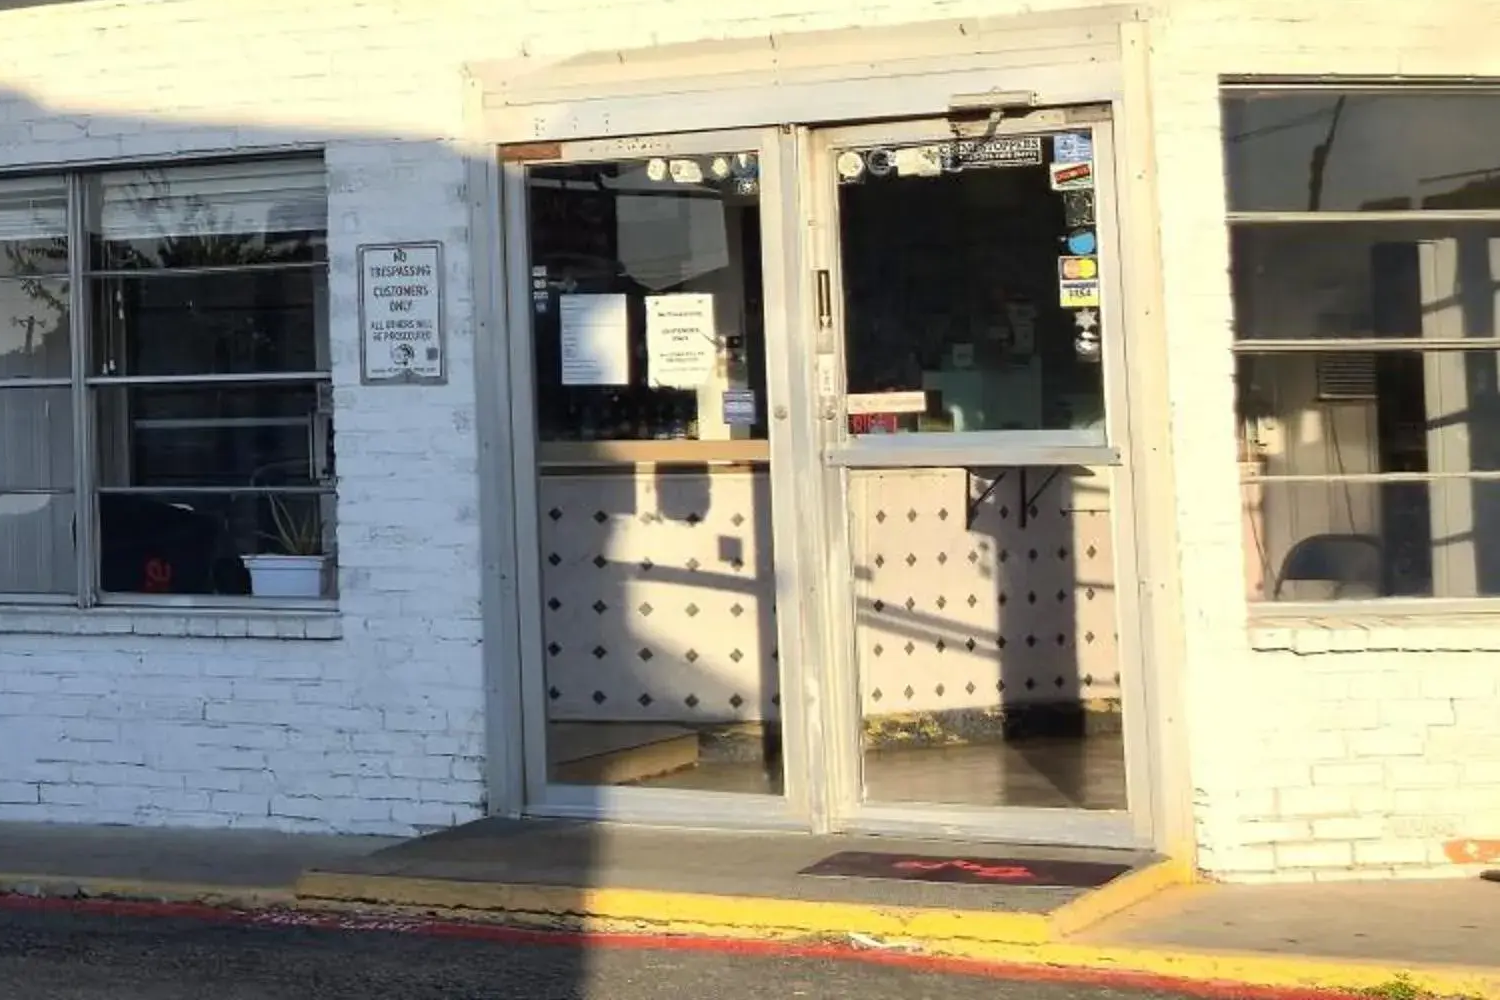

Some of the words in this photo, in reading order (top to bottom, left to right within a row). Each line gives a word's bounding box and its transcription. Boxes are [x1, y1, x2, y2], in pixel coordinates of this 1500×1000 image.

[393, 251, 407, 262] NO
[371, 266, 431, 277] TRESPASSING
[374, 286, 428, 297] CUSTOMERS
[389, 300, 412, 312] ONLY
